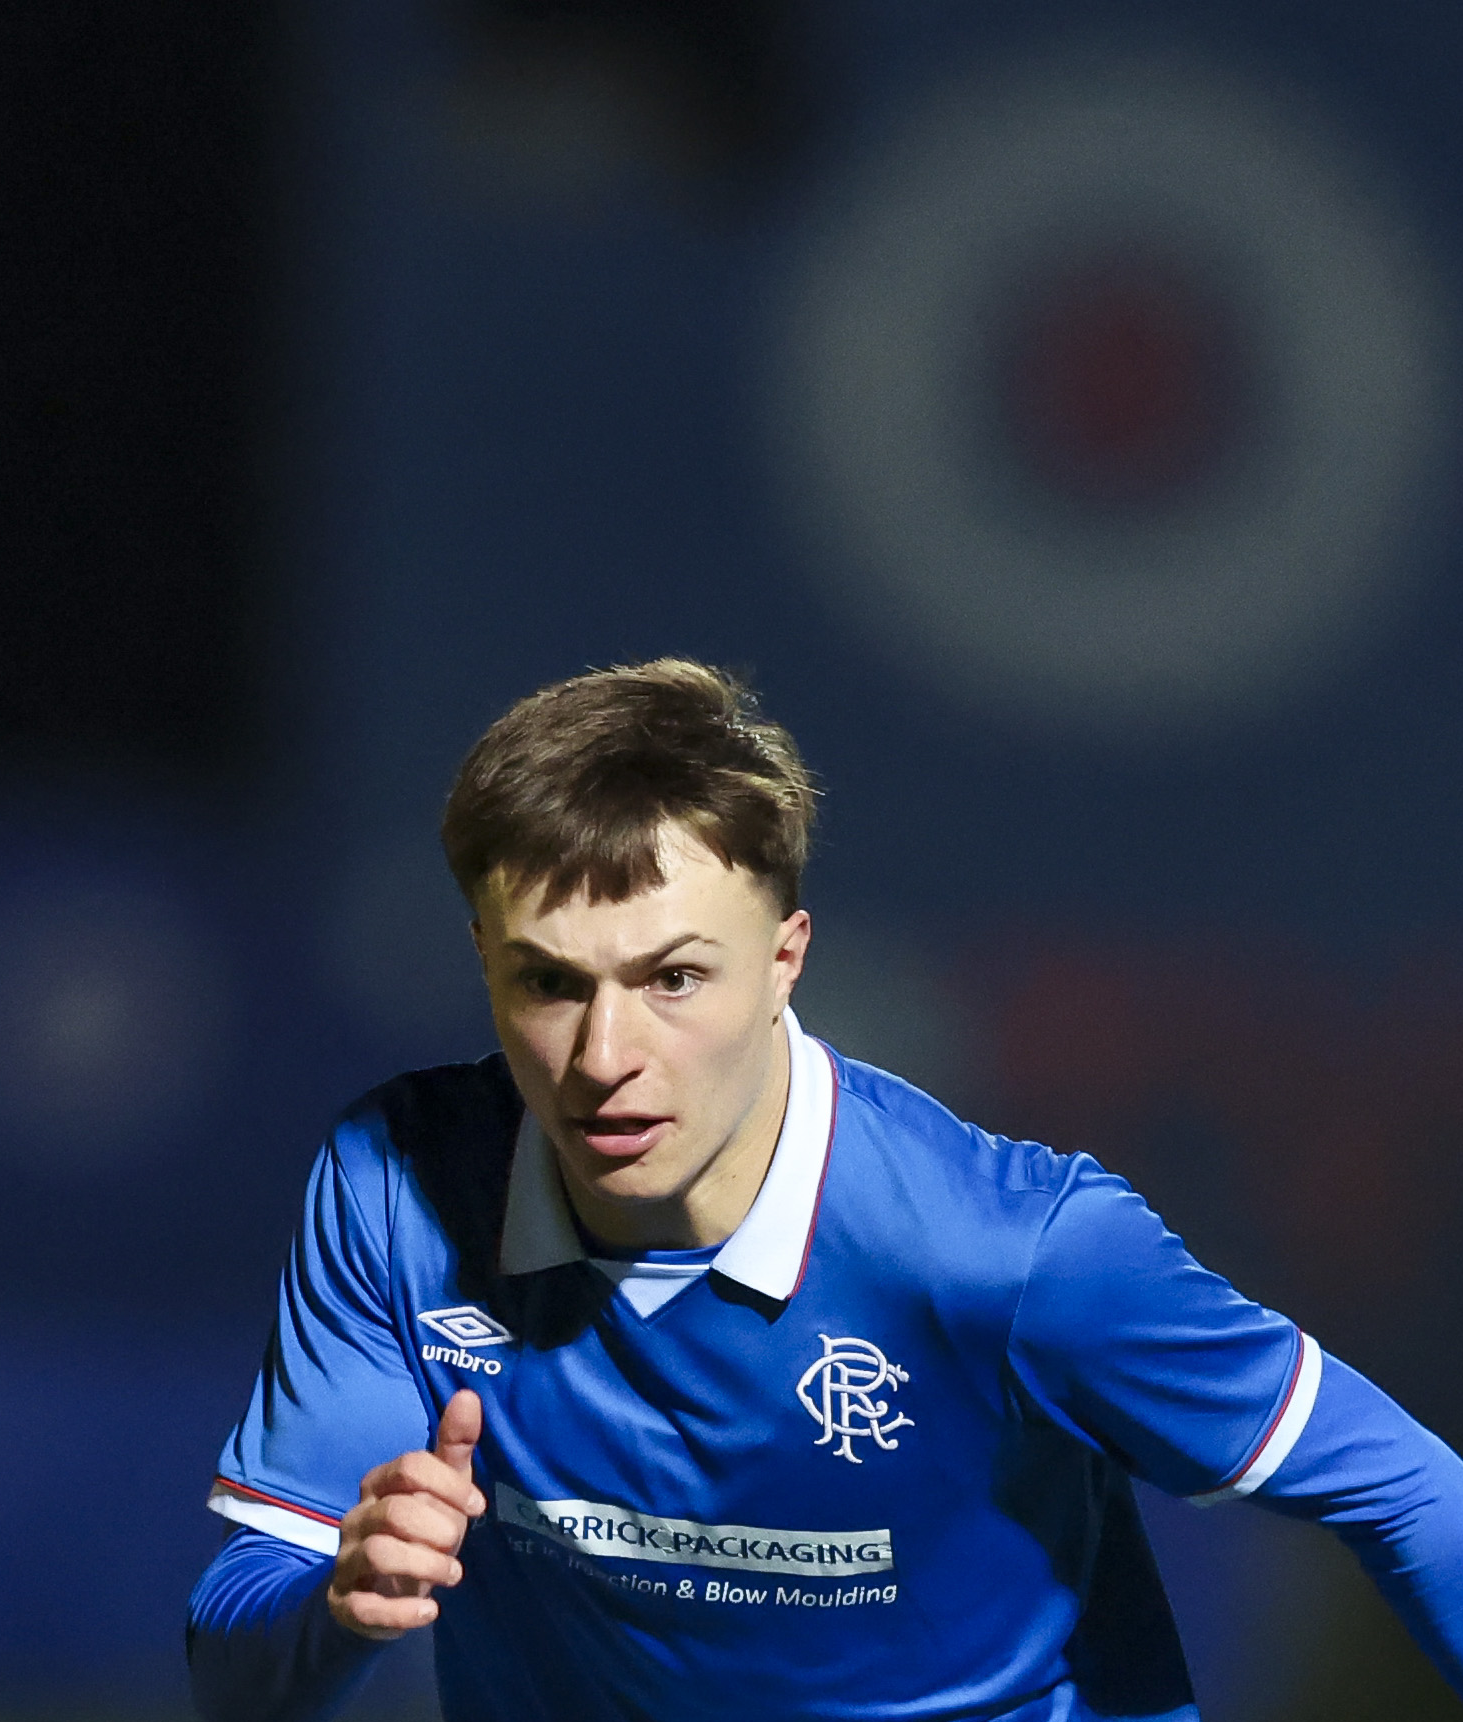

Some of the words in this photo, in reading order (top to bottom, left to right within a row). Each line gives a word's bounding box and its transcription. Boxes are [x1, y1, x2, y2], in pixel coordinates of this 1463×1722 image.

[421, 1344, 502, 1376] umbro
[673, 1531, 881, 1565] PACKAGING
[675, 1579, 696, 1600] &
[705, 1581, 768, 1605] Blow
[775, 1584, 898, 1608] Moulding
